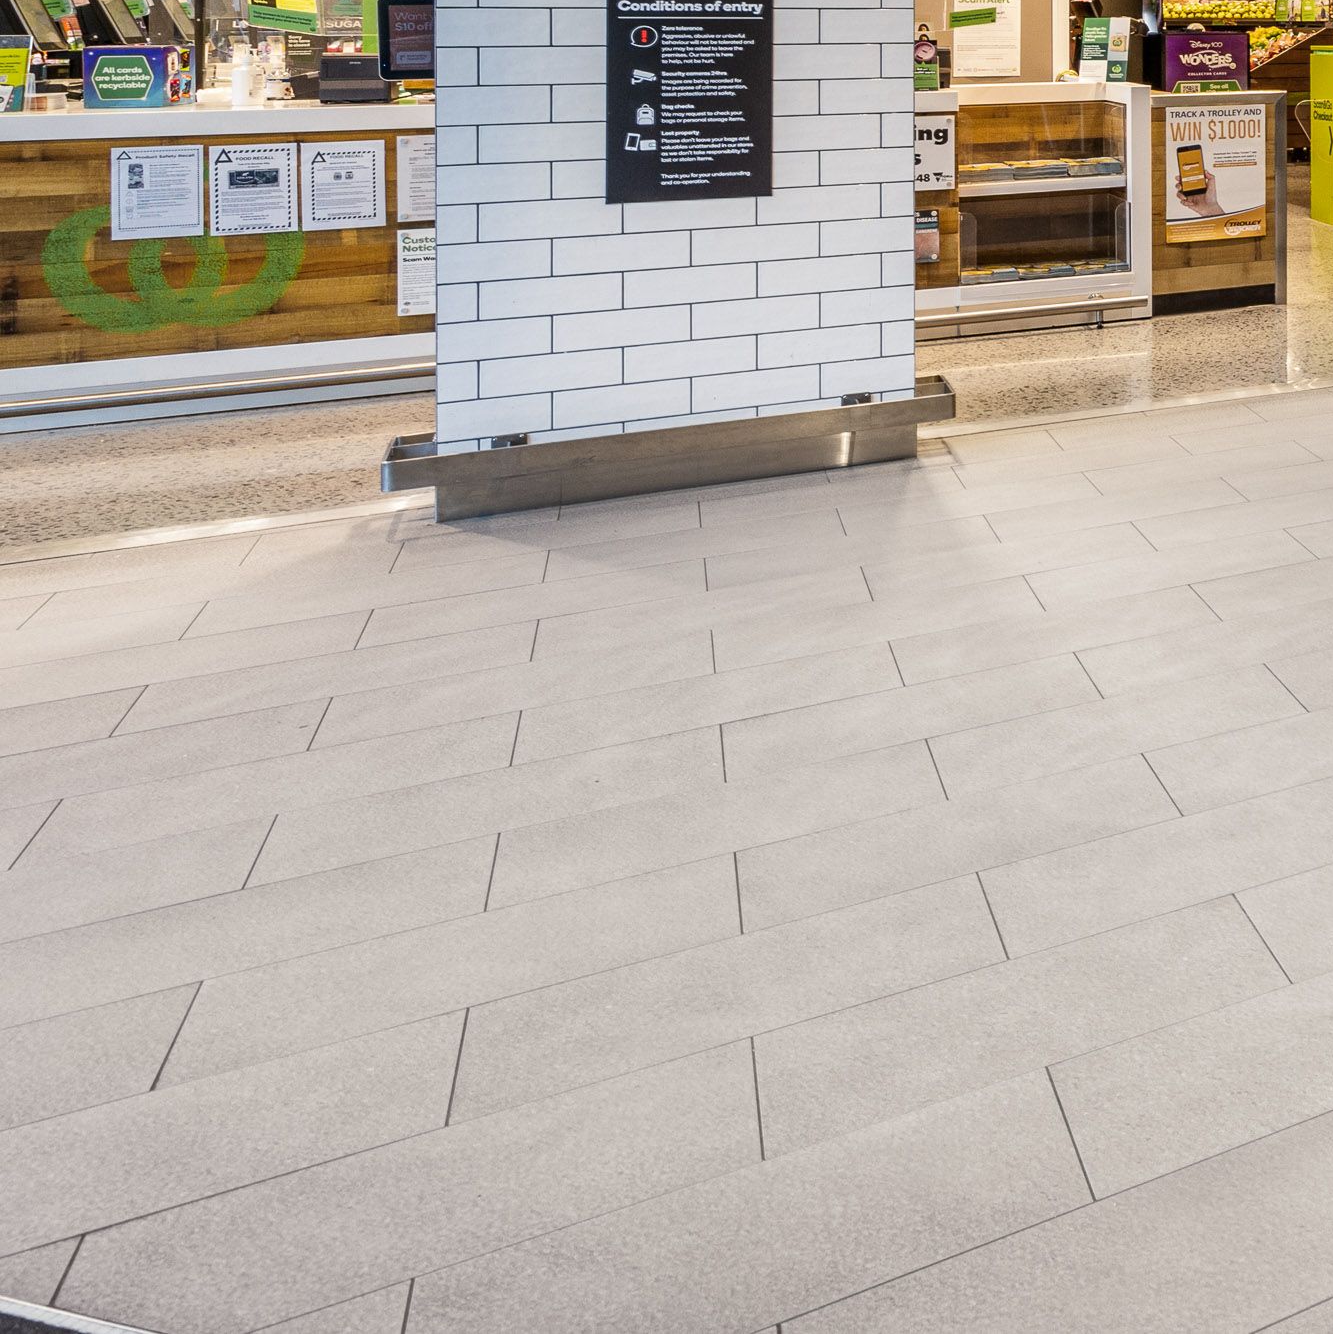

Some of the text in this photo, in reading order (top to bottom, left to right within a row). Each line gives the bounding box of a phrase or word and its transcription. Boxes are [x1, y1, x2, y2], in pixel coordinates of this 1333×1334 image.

[617, 0, 763, 15] Conditions of entry
[1179, 52, 1235, 68] WONDERS
[102, 66, 142, 74] All cards
[98, 82, 146, 90] recyclable
[1207, 109, 1242, 117] TROLLEY
[1170, 119, 1261, 142] WIN $1000!
[402, 236, 436, 245] Custo
